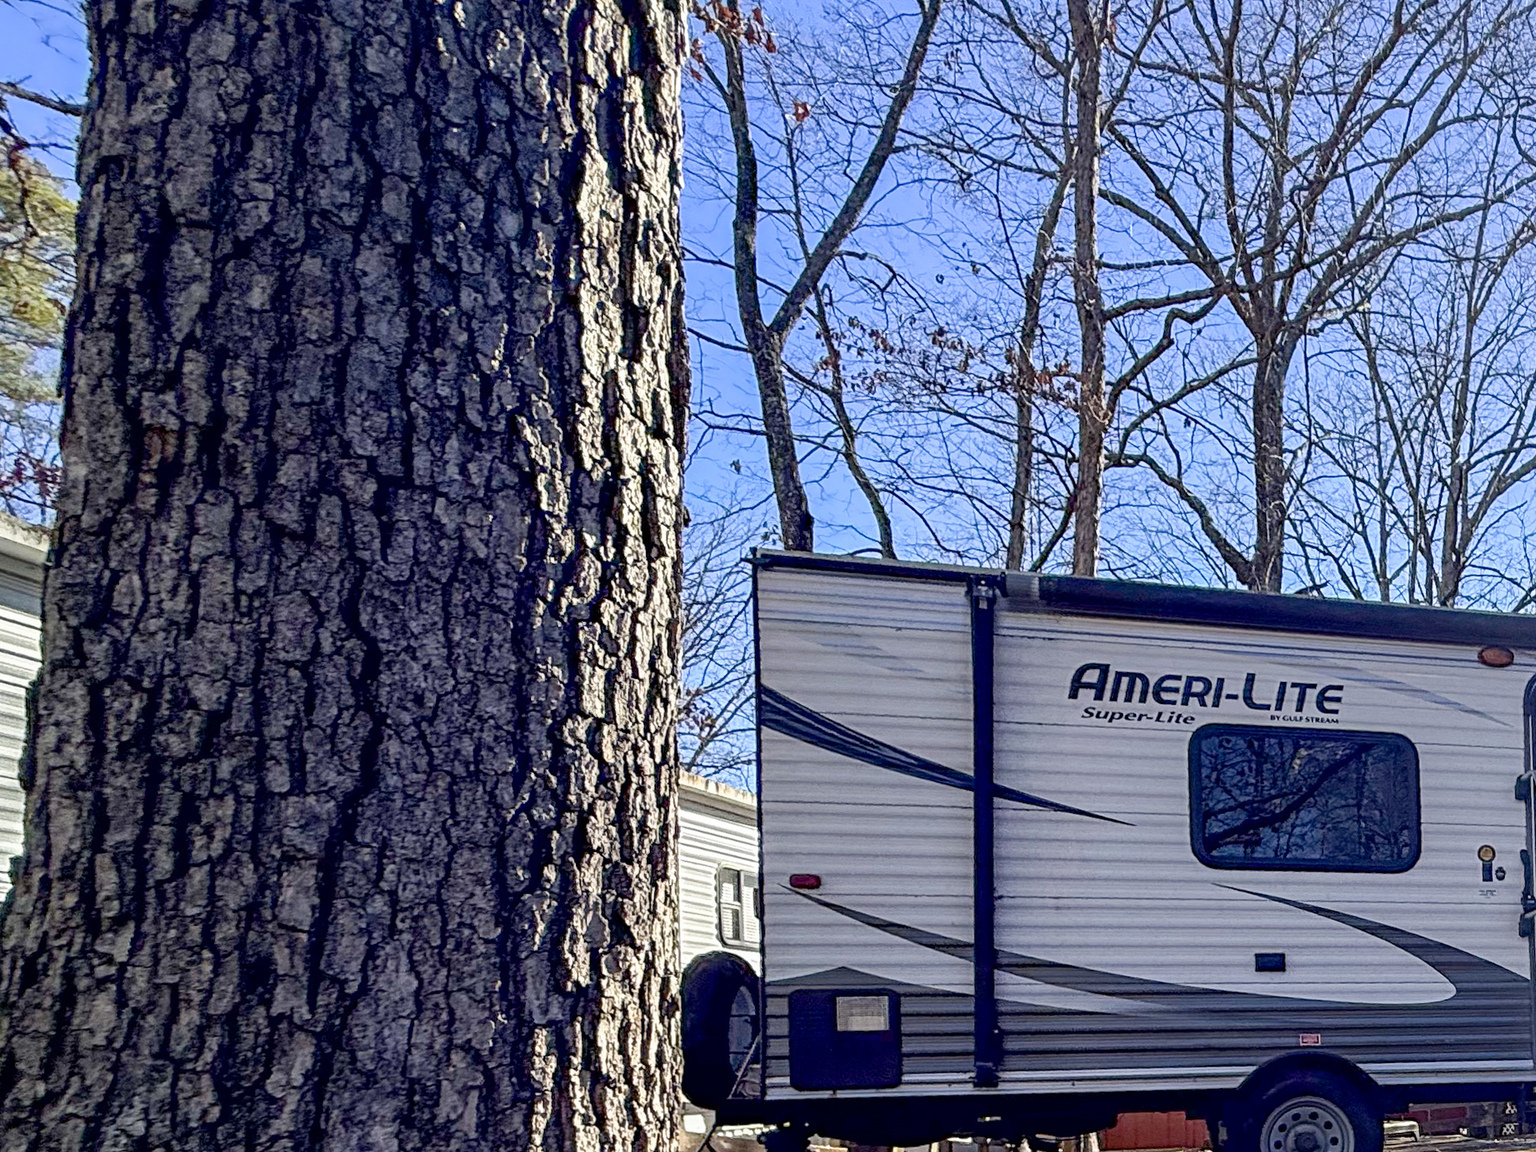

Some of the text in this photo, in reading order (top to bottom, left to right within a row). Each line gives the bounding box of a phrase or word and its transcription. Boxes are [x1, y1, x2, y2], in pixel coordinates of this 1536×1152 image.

[1067, 662, 1345, 715] AMERI-LITE
[1081, 706, 1196, 725] Super-Lite
[1305, 716, 1339, 724] STREAM
